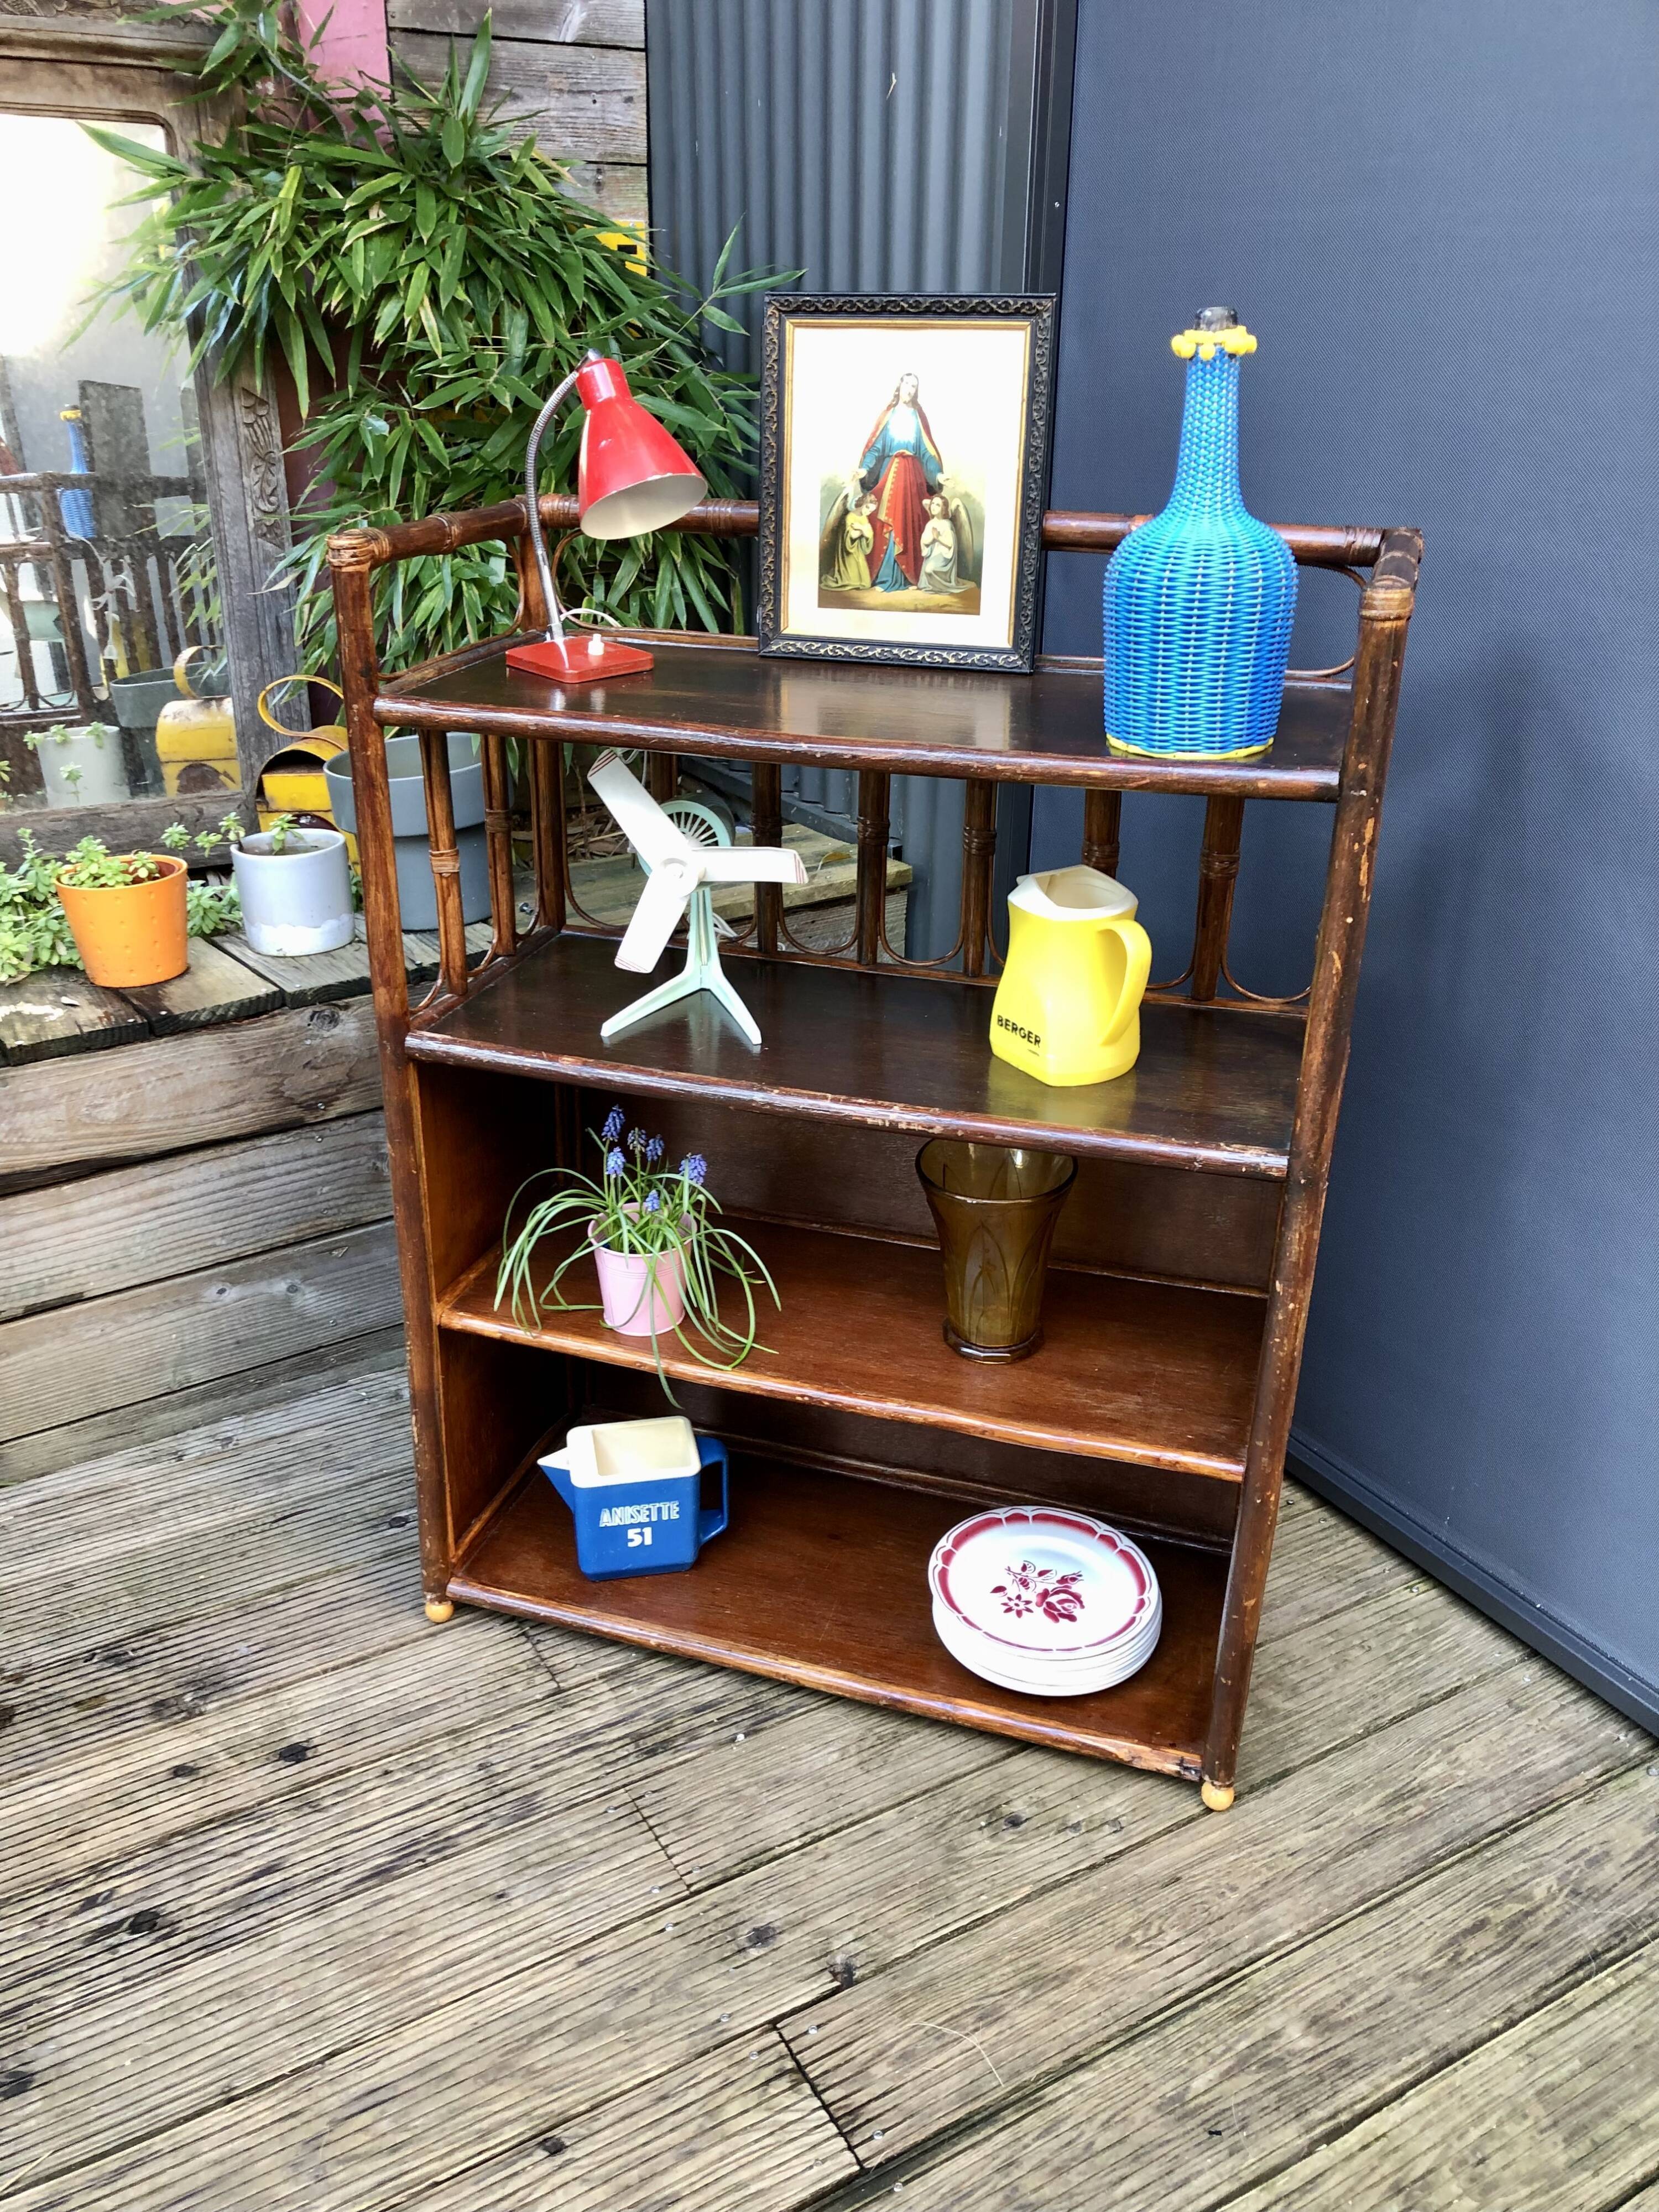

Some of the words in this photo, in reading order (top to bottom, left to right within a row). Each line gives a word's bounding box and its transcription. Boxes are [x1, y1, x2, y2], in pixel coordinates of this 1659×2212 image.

[997, 1014, 1041, 1048] BERGER
[599, 1500, 680, 1527] ANISETTE
[627, 1527, 653, 1547] 51
